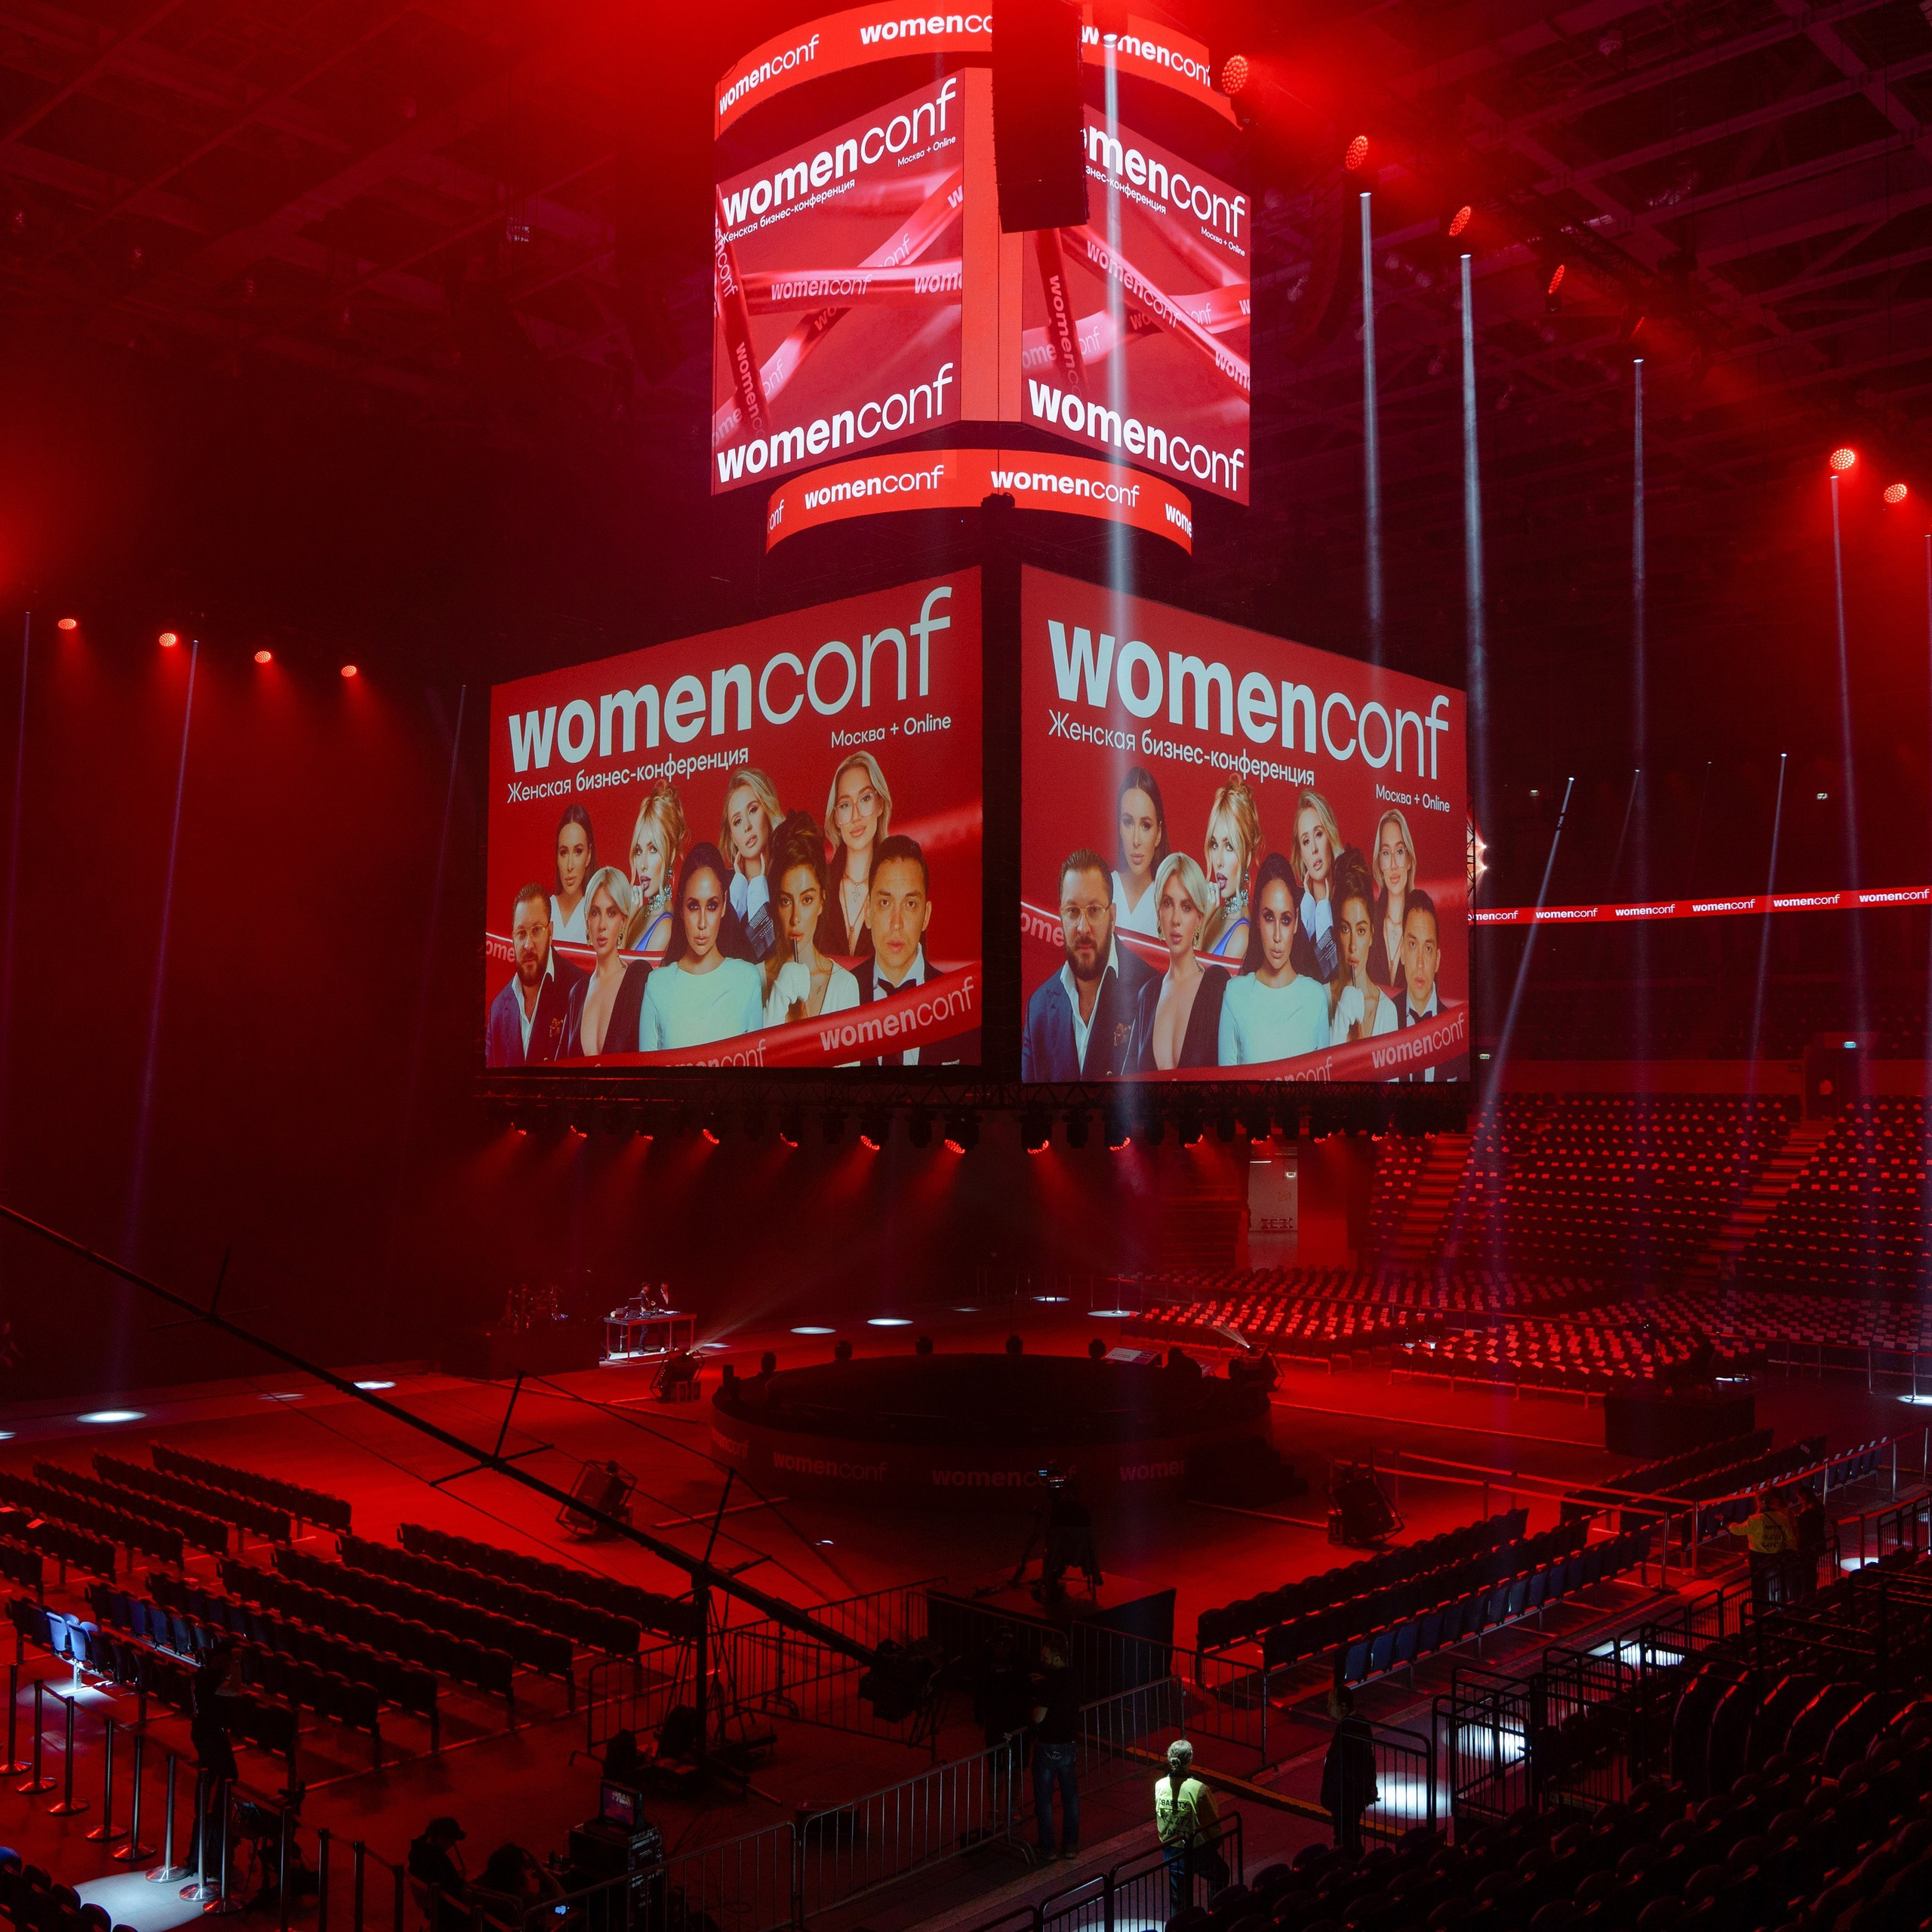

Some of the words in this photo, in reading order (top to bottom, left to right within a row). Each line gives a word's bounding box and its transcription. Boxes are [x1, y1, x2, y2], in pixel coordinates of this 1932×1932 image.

[720, 34, 820, 115] womenconf
[722, 77, 957, 226] womenconf
[898, 149, 924, 167] Москва
[933, 135, 956, 152] Online
[1081, 125, 1245, 238] menconf
[720, 222, 758, 245] Женская
[760, 179, 855, 226] бизнес-конференция
[877, 232, 909, 267] onf
[1201, 226, 1223, 245] Москва
[1229, 242, 1245, 257] Online
[771, 274, 872, 300] womenconf
[914, 272, 962, 294] wom
[1087, 240, 1182, 328] womenconf
[717, 362, 953, 483] womenconf
[1028, 378, 1244, 491] womenconf
[804, 465, 944, 509] womenconf
[990, 469, 1140, 508] womenconf
[508, 586, 952, 774] womenconf
[1048, 619, 1450, 780] womenconf
[831, 727, 885, 749] Москва
[904, 713, 952, 735] Online
[1048, 709, 1137, 752] Женская
[1141, 728, 1315, 787] бизнес-конференция
[506, 777, 571, 804] Женская
[576, 747, 749, 792] бизнес-конференция
[1375, 783, 1411, 806] Москва
[1423, 792, 1450, 813] Online
[1535, 908, 1598, 919] womenconf
[1615, 904, 1675, 916] womenconf
[1693, 899, 1755, 912] womenconf
[1774, 894, 1840, 907] womenconf
[1859, 888, 1930, 903] womenconf
[820, 977, 974, 1052] womenconf
[1371, 1012, 1464, 1069] womenconf
[773, 1451, 888, 1481] womenconf
